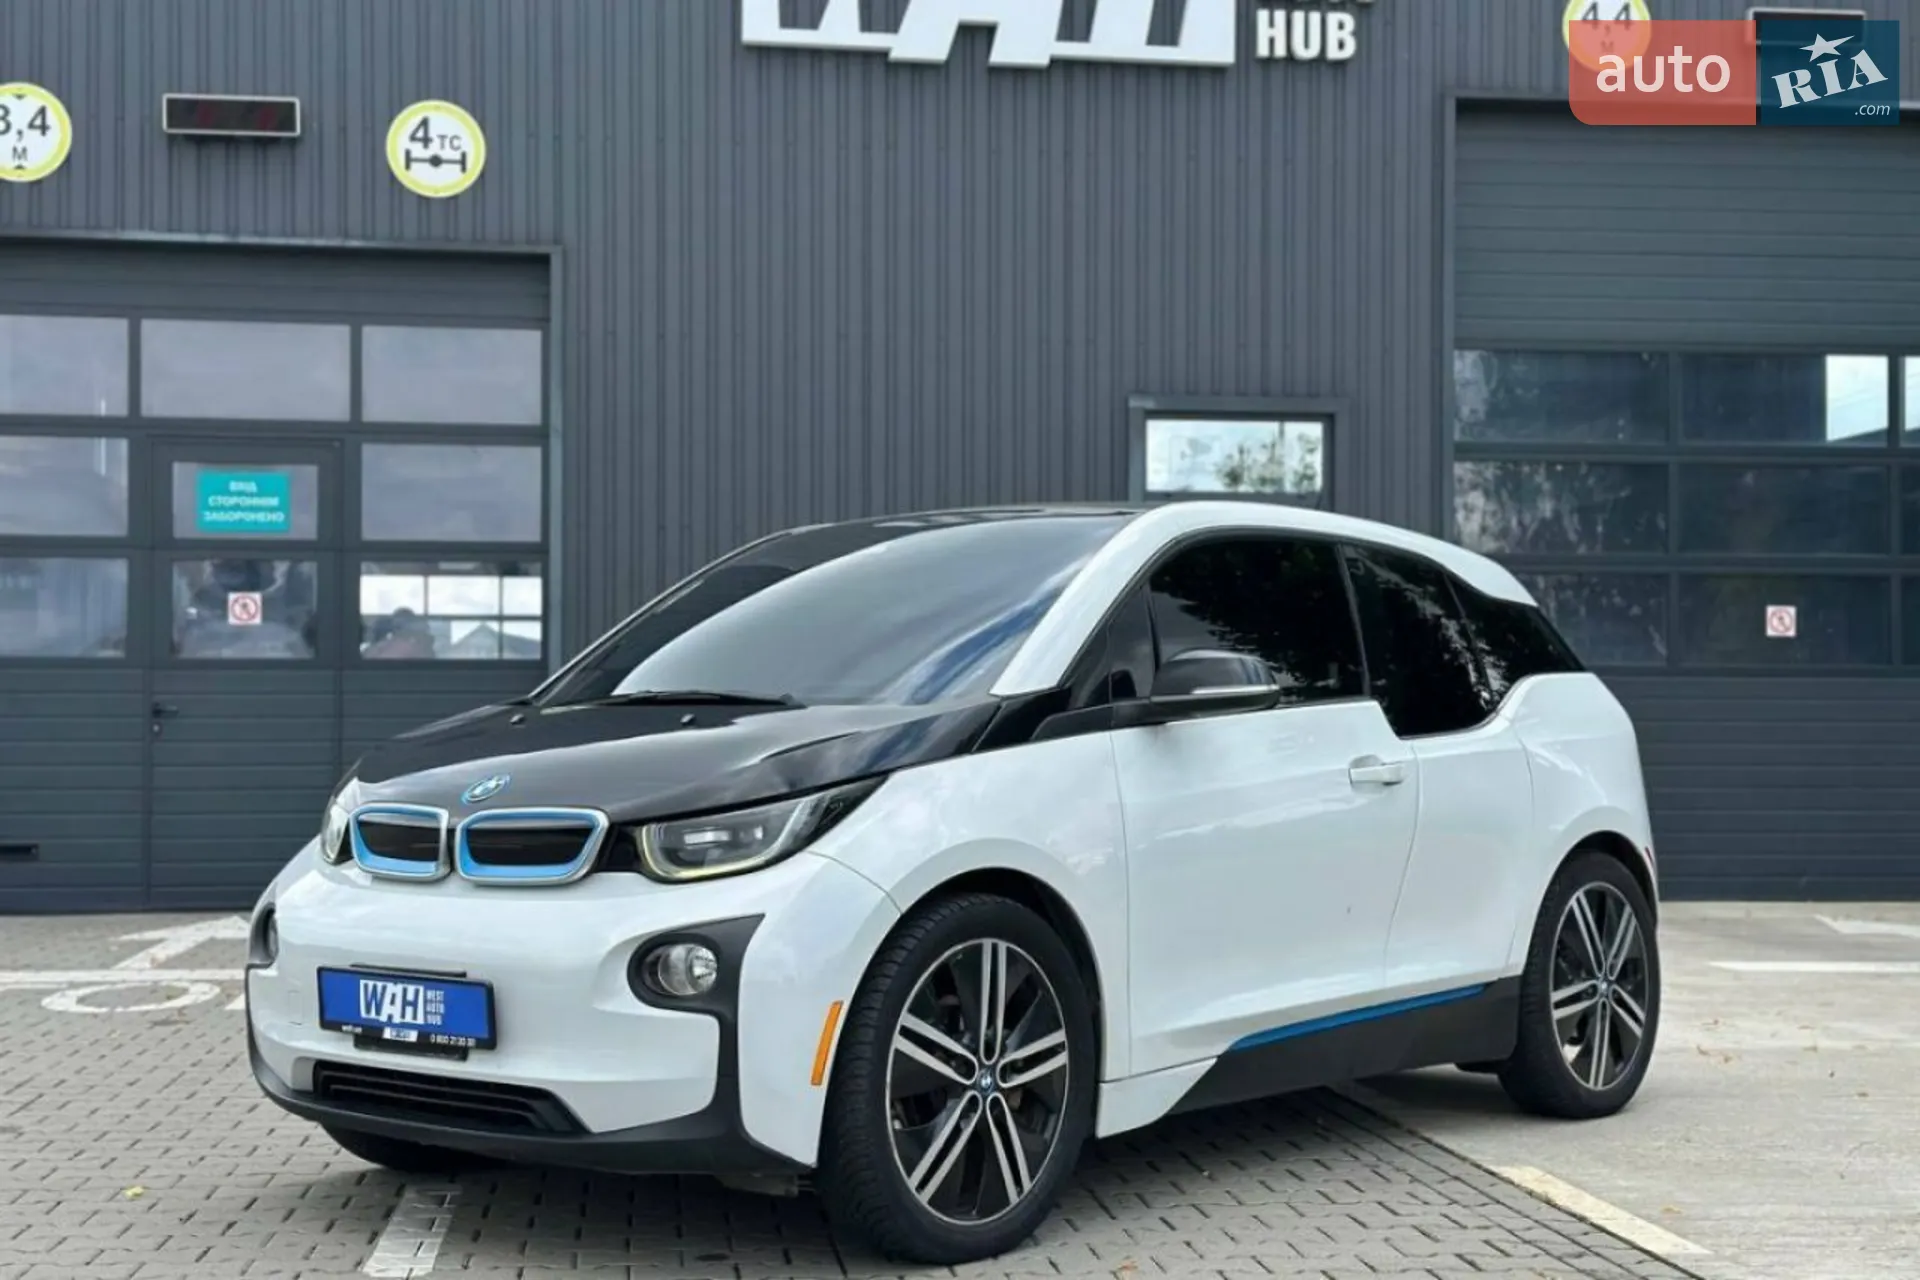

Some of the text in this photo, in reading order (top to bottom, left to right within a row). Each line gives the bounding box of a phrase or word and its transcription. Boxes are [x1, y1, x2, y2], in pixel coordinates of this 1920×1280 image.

[1256, 9, 1357, 61] HUB
[409, 116, 433, 150] 4
[360, 979, 425, 1024] WAH
